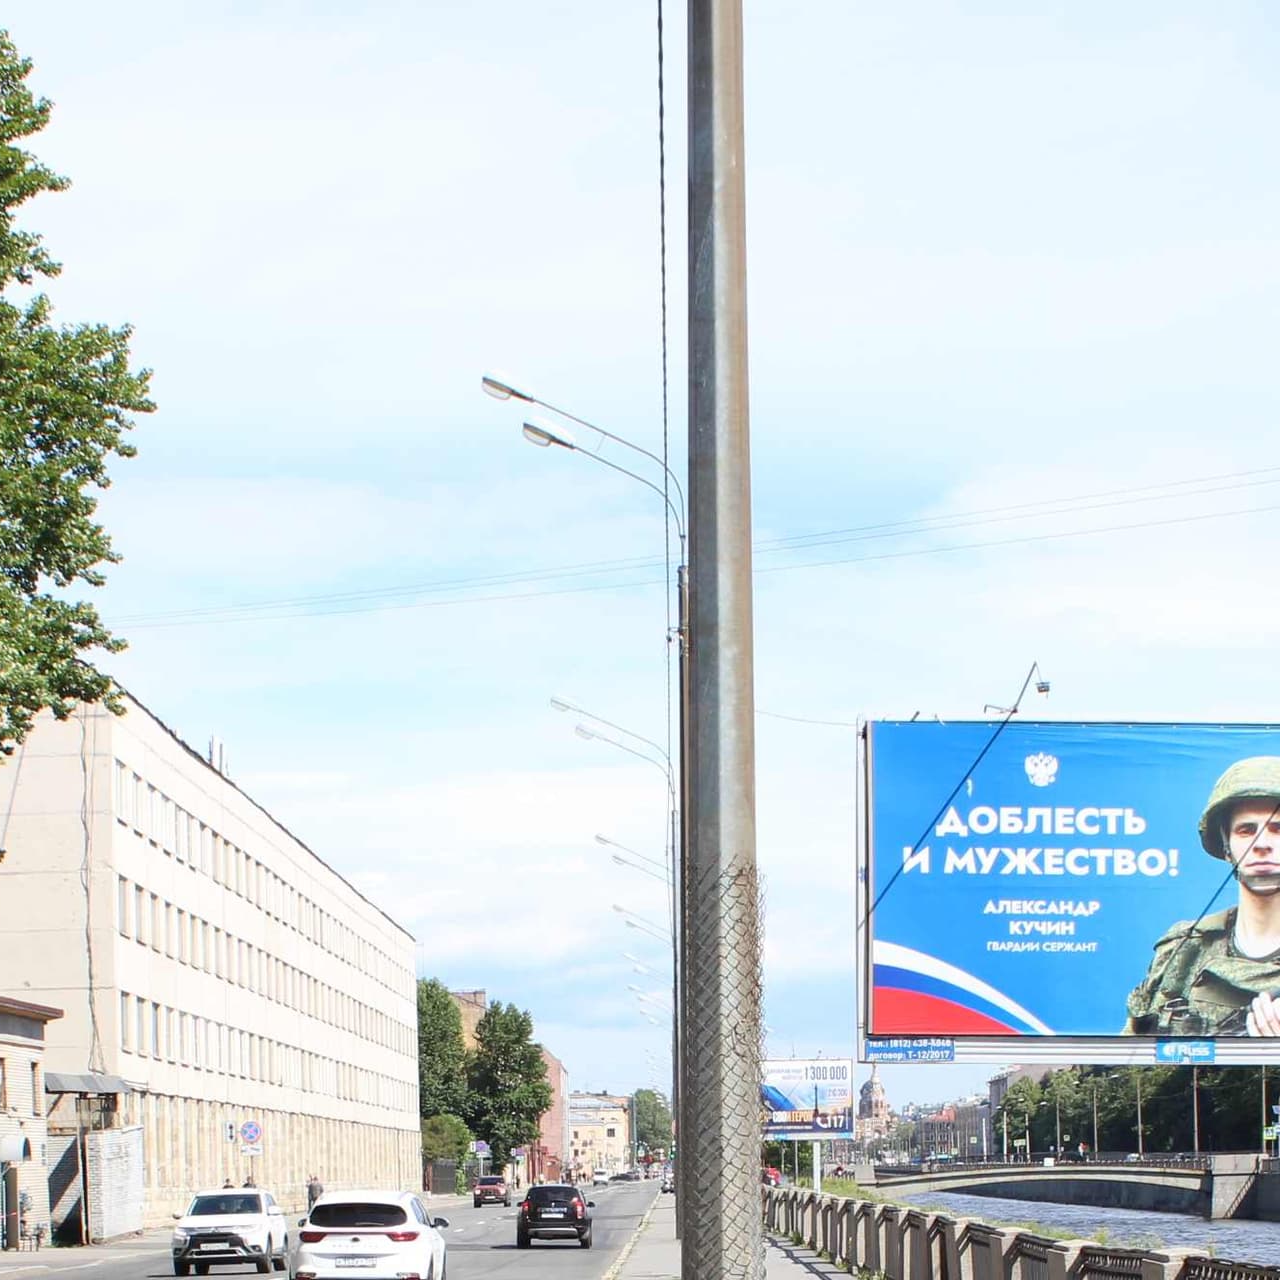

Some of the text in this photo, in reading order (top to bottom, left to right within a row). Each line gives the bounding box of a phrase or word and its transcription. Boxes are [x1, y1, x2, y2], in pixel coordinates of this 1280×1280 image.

[935, 805, 1147, 837] ДОБЛЕСТЬ
[902, 846, 1180, 877] И МУЖЕСТВО!
[983, 899, 1101, 917] АЛЕКСАНДР
[1009, 920, 1075, 936] КУЧИН
[986, 941, 1098, 953] ГВАРДИИ СЕРЖАНТ
[810, 1066, 828, 1081] 300
[829, 1065, 848, 1081] 000
[826, 1115, 845, 1129] 117
